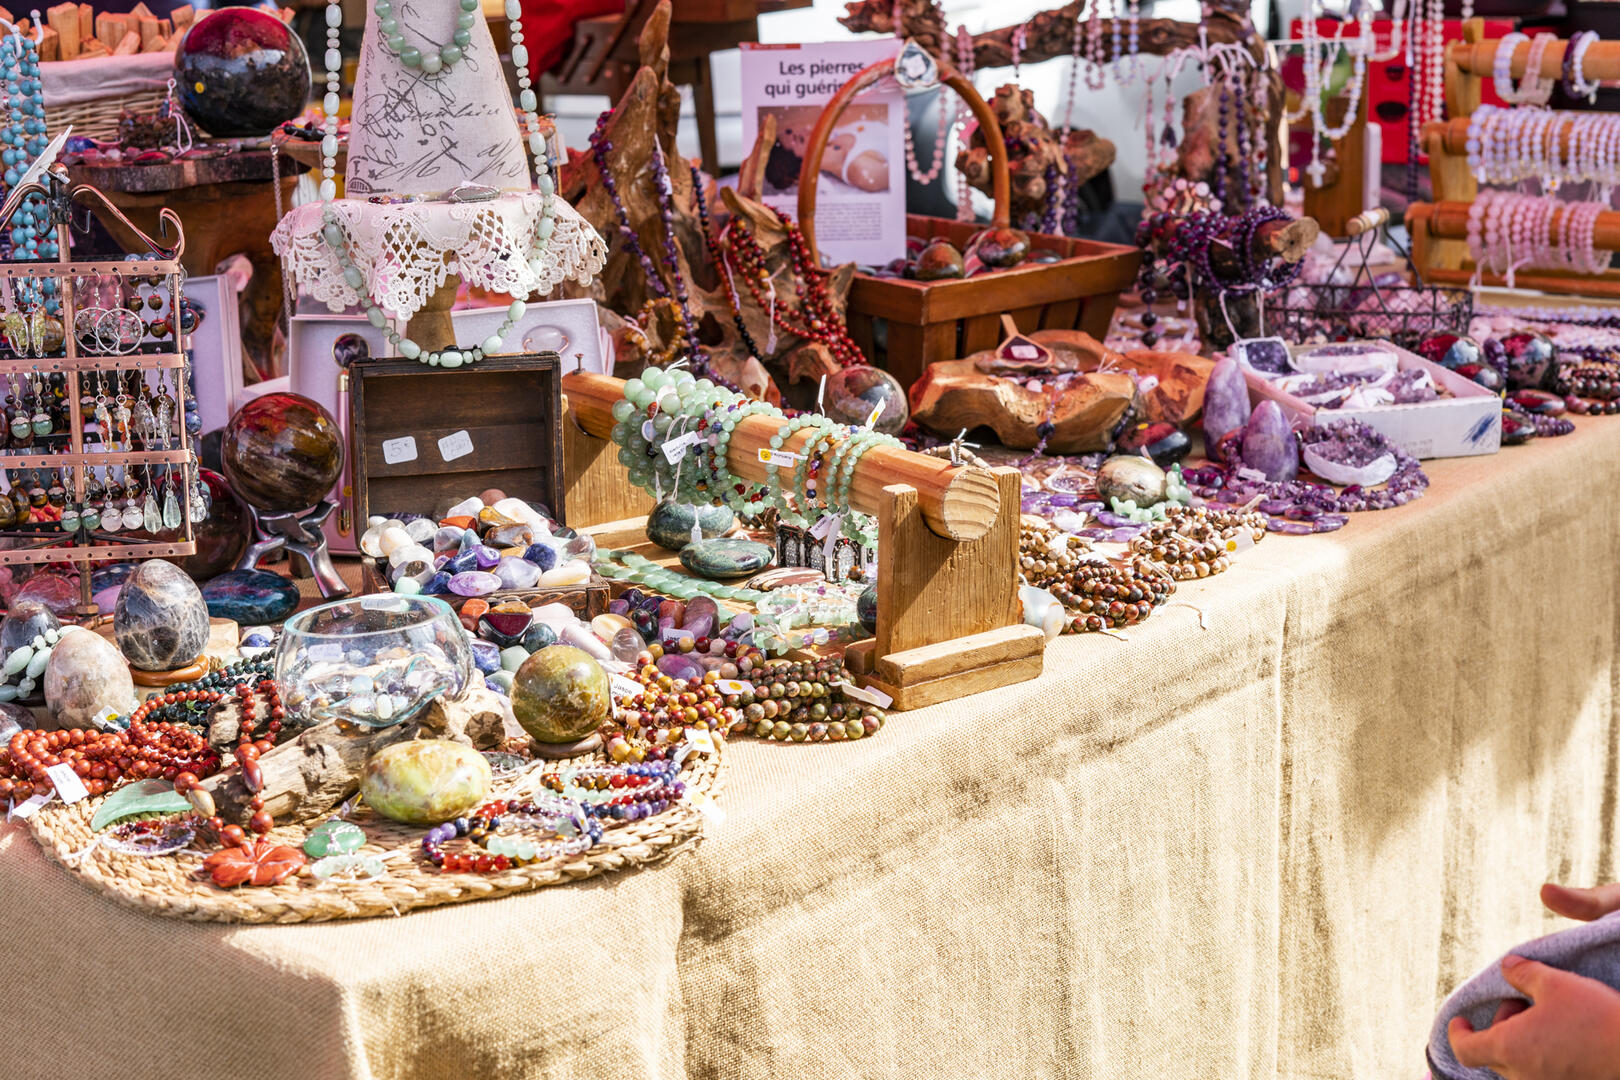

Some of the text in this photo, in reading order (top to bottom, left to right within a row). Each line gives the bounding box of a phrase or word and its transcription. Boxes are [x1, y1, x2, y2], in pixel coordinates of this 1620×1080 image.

[779, 59, 864, 78] Les pierres
[764, 80, 790, 98] qui
